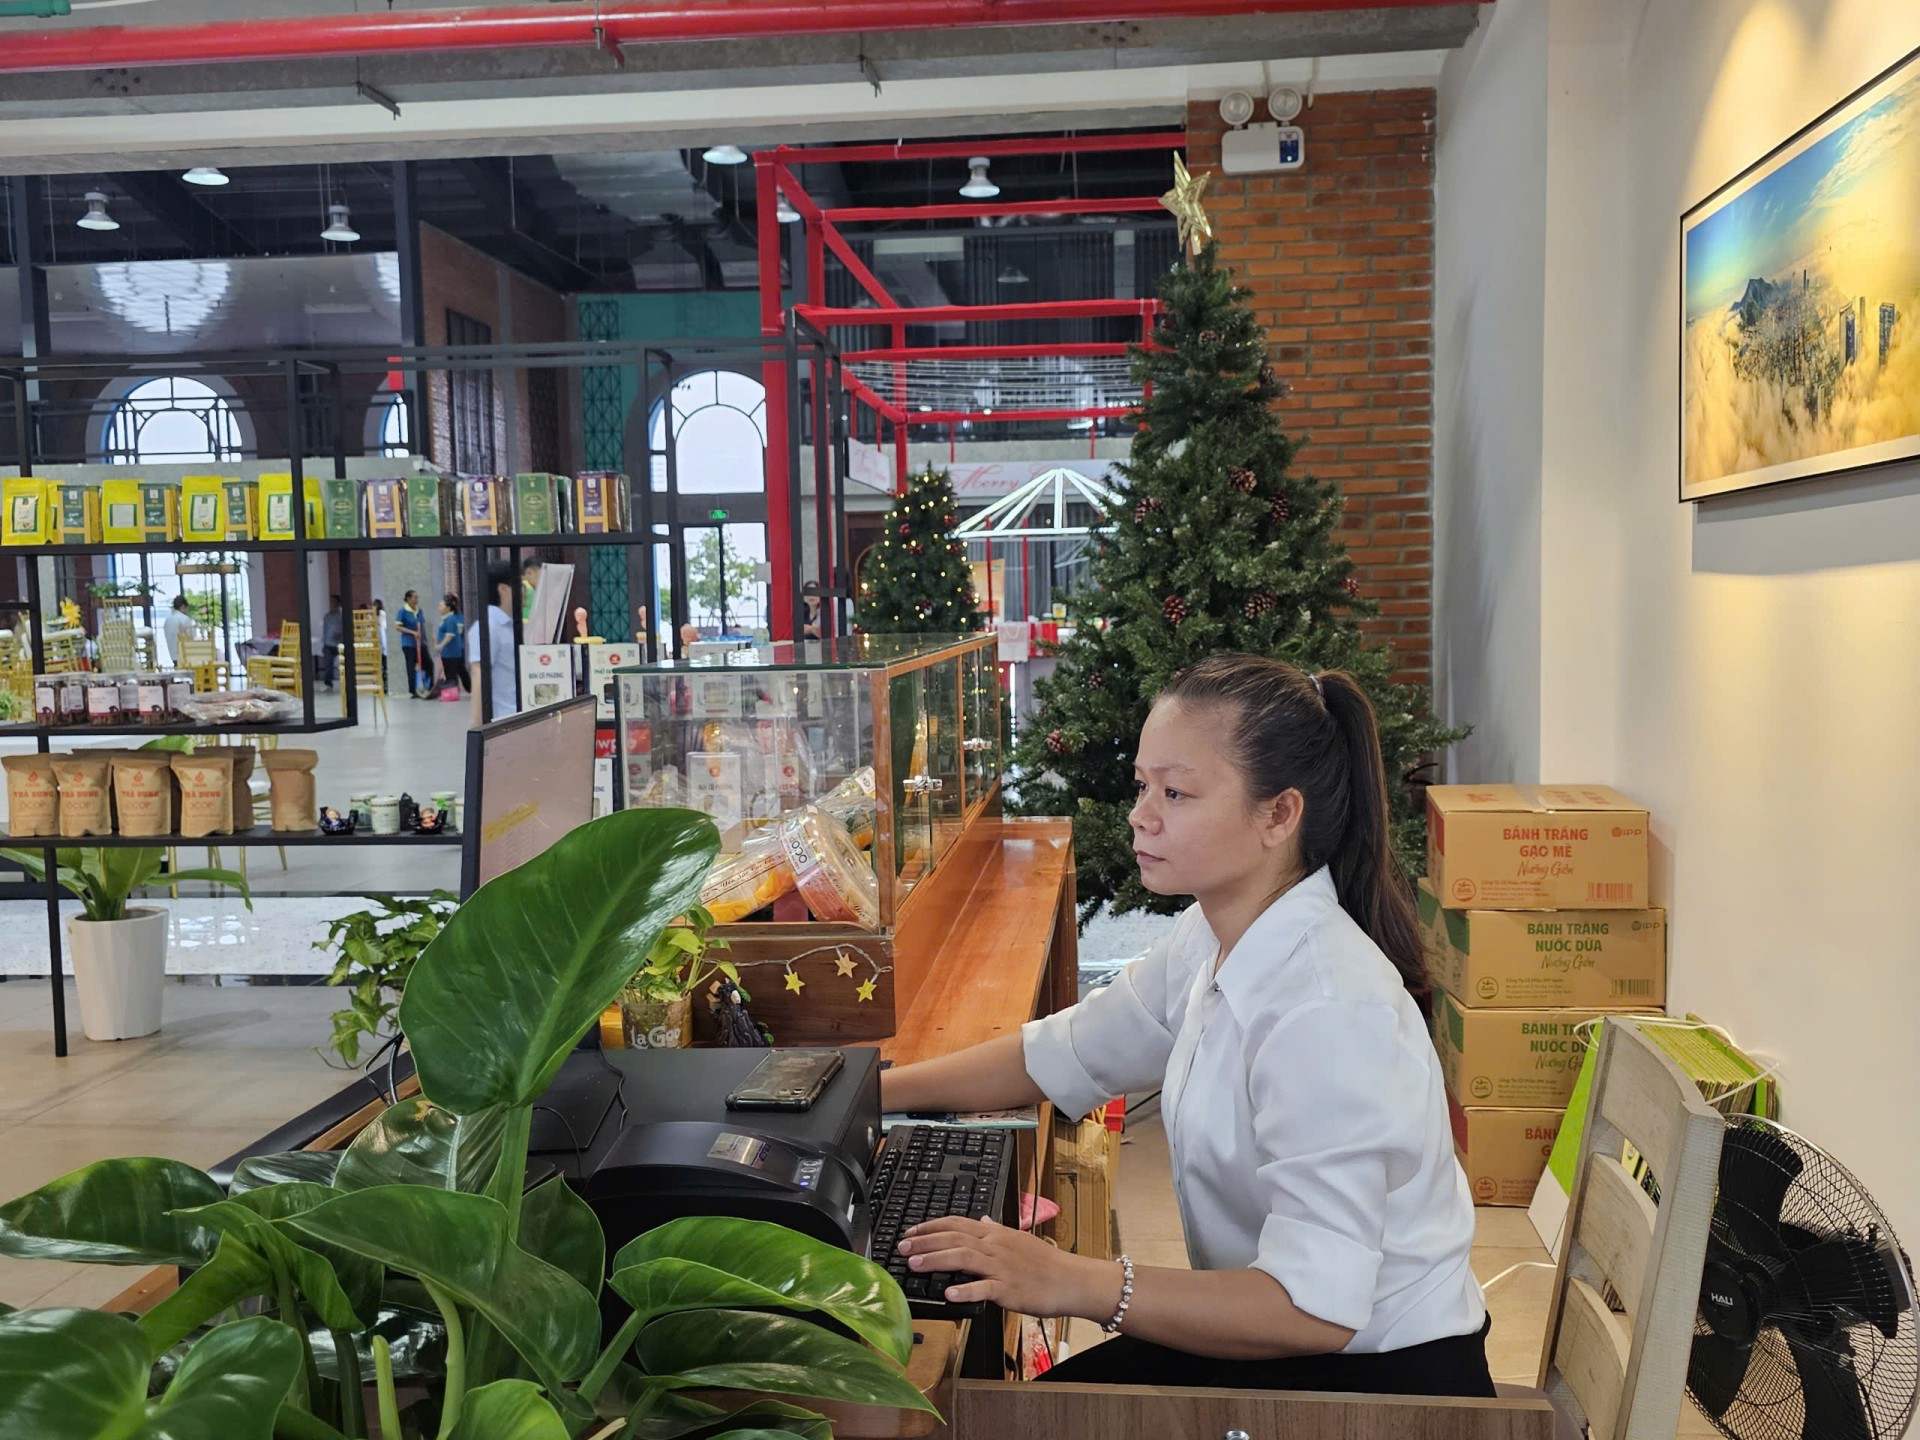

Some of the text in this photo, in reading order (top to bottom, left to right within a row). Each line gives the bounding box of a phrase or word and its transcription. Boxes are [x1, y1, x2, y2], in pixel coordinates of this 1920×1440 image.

[1503, 826, 1588, 840] BÁNH TRÁNG
[1520, 845, 1548, 860] GẠO
[1527, 921, 1562, 935] BÁNH
[1711, 1292, 1734, 1306] HALI
